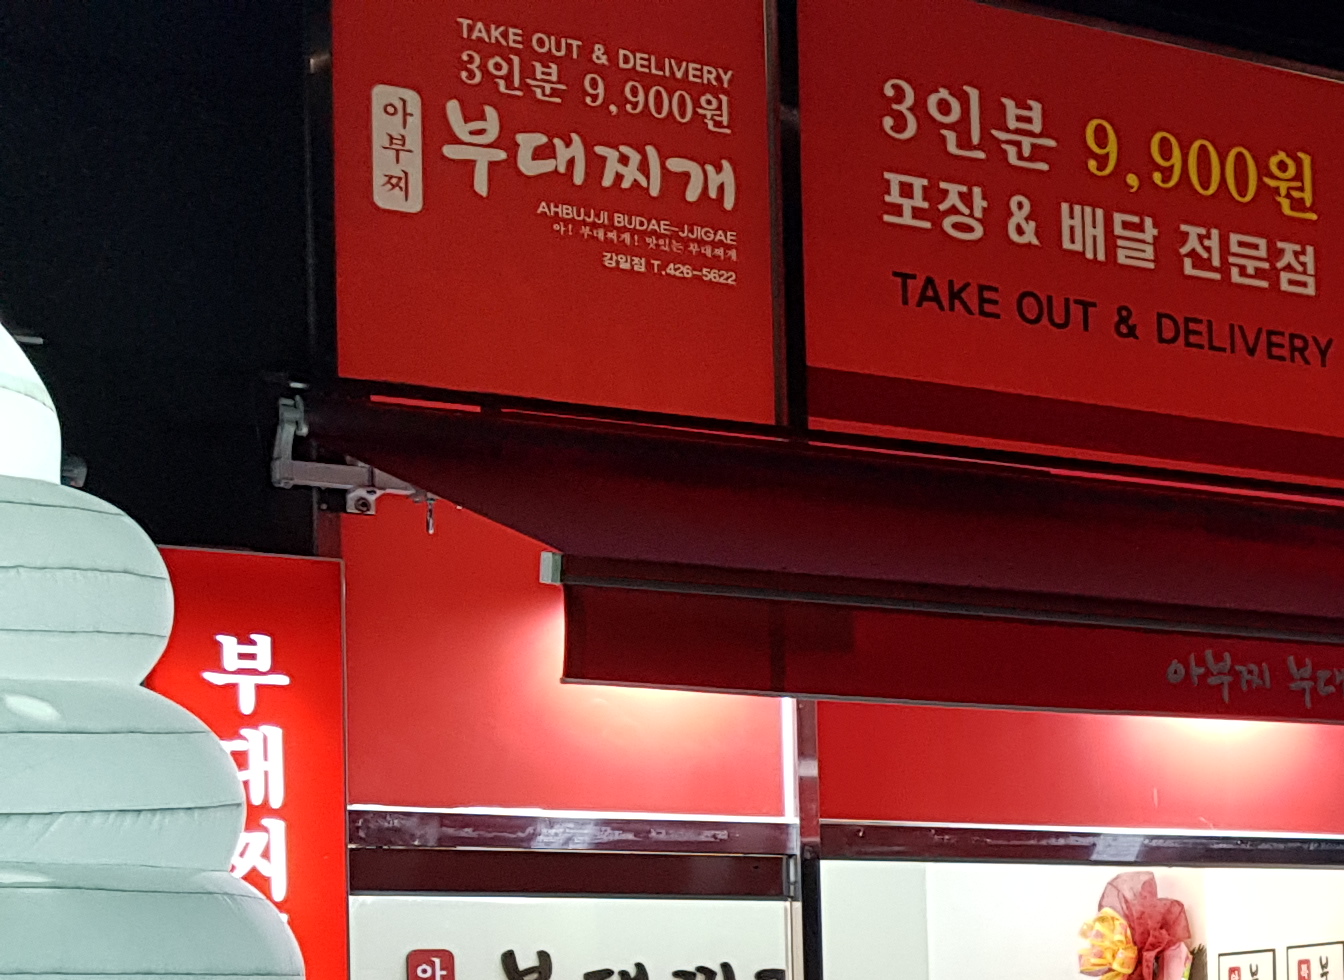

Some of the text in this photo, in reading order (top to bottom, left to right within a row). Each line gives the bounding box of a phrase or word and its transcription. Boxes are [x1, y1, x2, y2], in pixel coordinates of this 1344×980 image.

[457, 17, 733, 89] TAKE OUT & DELIVERY
[459, 50, 732, 134] 3인분 9,900원
[381, 96, 414, 202] 아부찌
[442, 98, 737, 210] 부대찌개
[882, 78, 1318, 221] 3인분 9,900원
[537, 201, 737, 245] AHBUJJI BUDAE-JJIGAE
[603, 252, 737, 285] 강일점 T.426-5622
[882, 171, 1317, 296] 포장 & 배달 전문점
[891, 271, 1334, 368] TAKE OUT & DELIVERY
[1166, 650, 1271, 703] 아부찌
[201, 634, 290, 924] 부대찌
